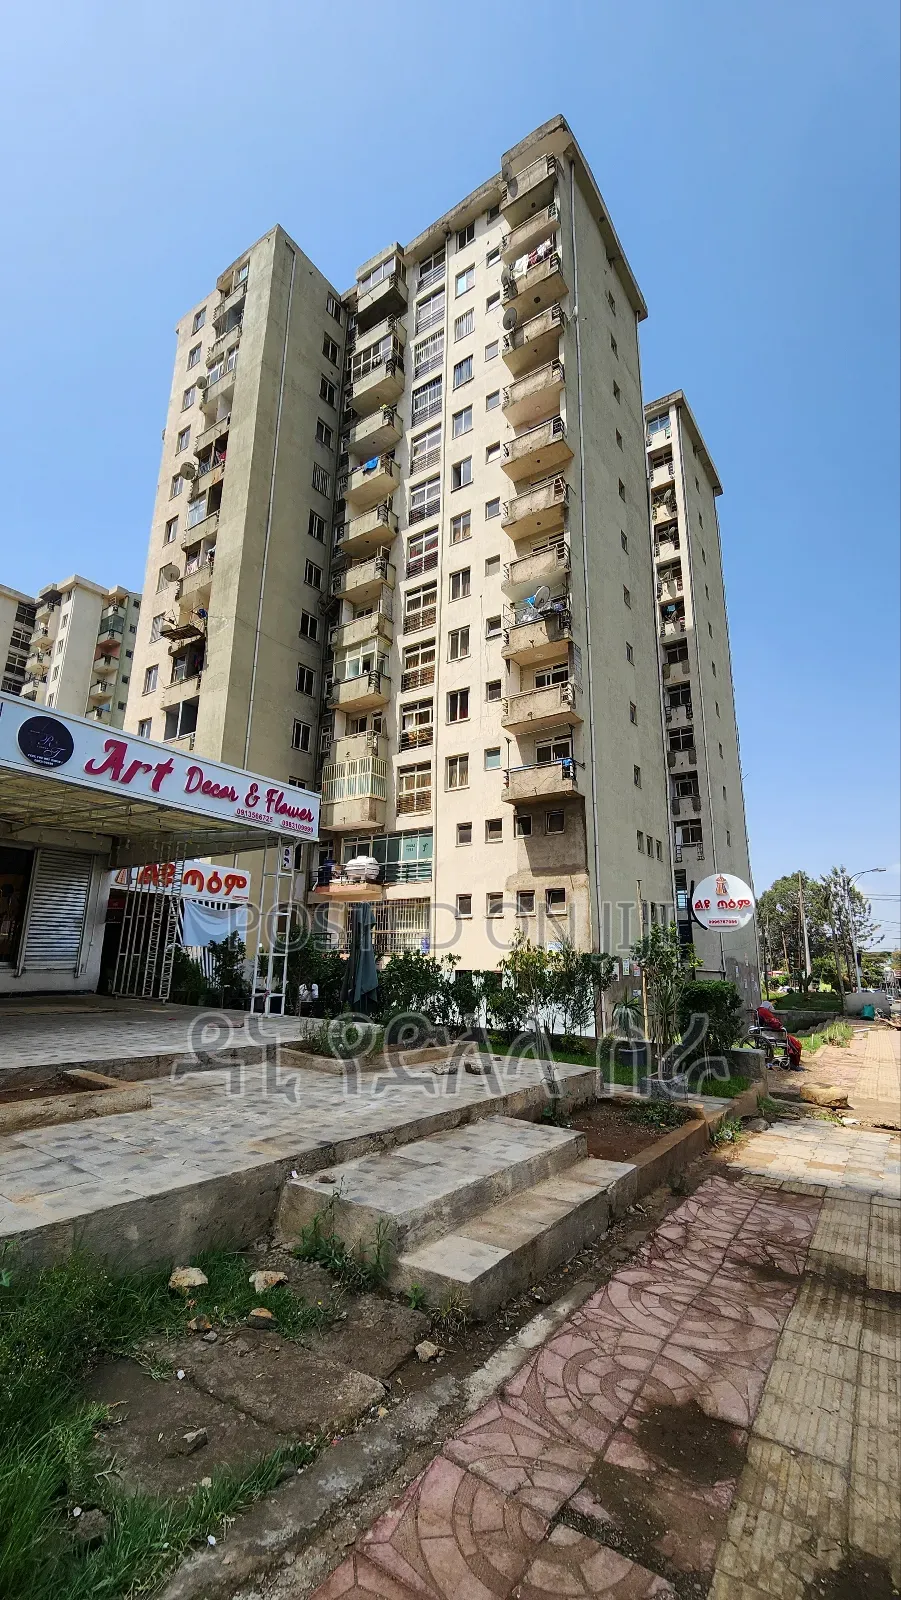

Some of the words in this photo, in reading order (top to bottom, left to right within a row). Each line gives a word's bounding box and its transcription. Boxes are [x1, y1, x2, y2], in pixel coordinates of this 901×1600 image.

[83, 738, 174, 792] Art
[184, 765, 239, 802] Decor
[244, 783, 260, 808] &
[265, 788, 315, 823] Flower
[182, 869, 247, 896] ጣዕም
[717, 898, 751, 909] ጣዕም
